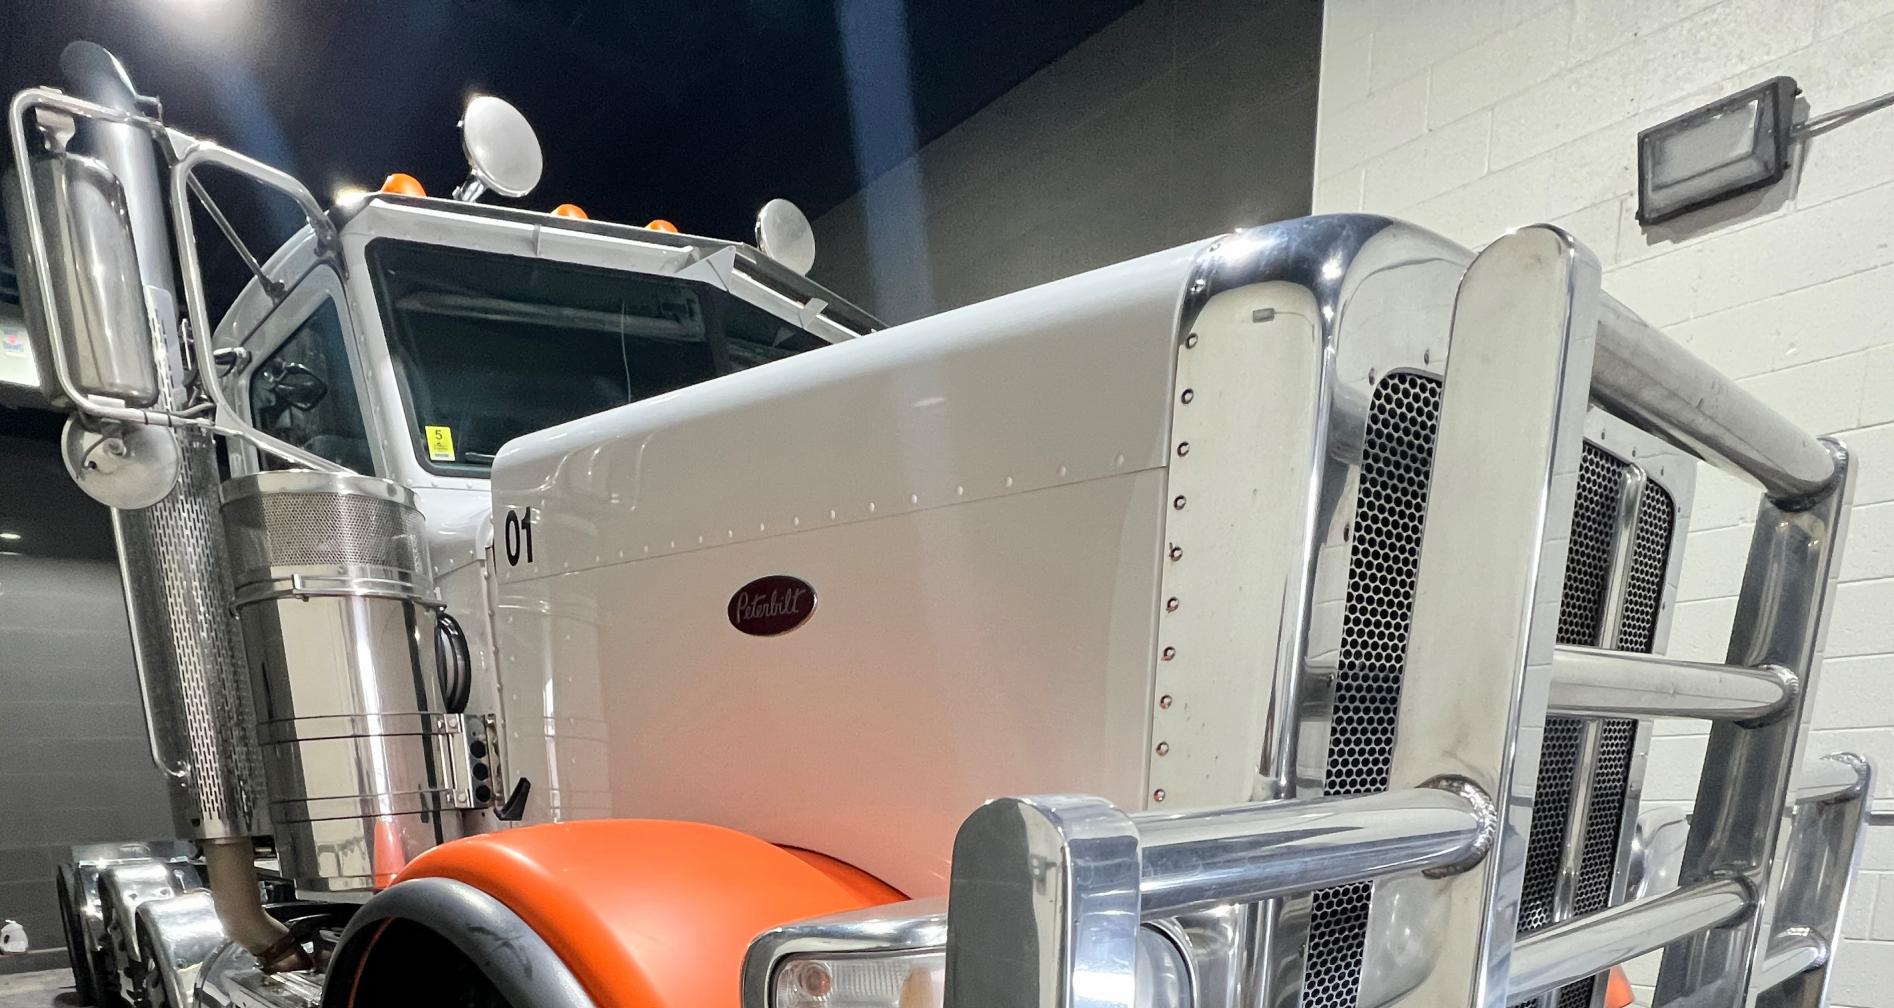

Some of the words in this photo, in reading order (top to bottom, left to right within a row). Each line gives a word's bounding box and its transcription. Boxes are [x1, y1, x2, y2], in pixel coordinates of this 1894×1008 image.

[435, 429, 443, 440] 5
[505, 506, 534, 567] 01
[736, 587, 806, 624] Peterbilt
